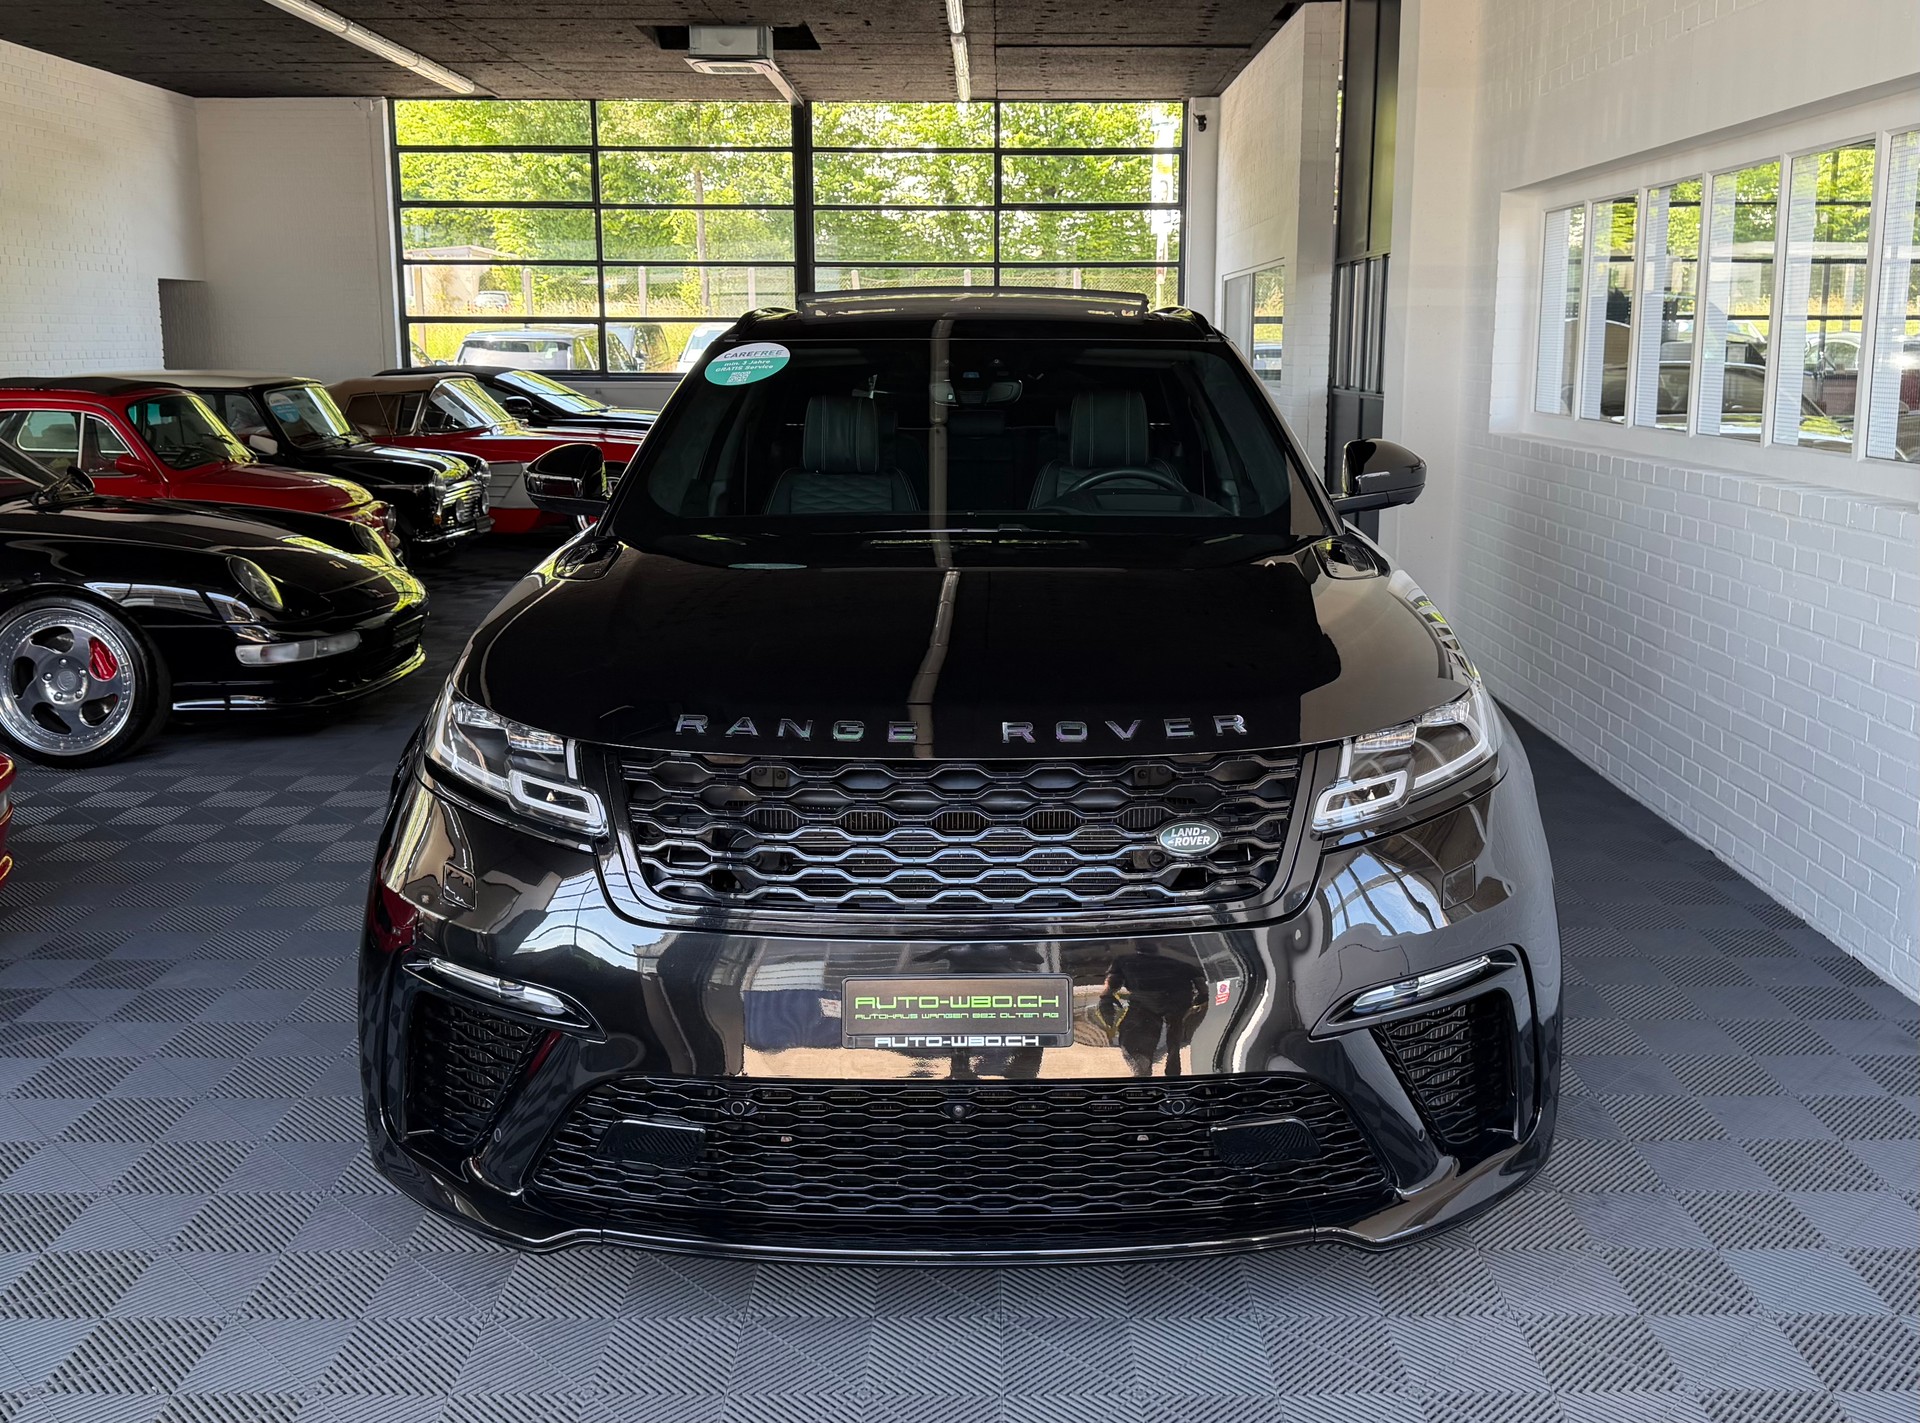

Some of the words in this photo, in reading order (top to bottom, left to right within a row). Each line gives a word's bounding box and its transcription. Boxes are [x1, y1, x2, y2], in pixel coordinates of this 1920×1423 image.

[724, 349, 784, 359] CAREFREE
[675, 714, 918, 743] RANGE
[1002, 714, 1248, 744] ROVER
[1171, 827, 1200, 837] LAND
[1174, 835, 1211, 847] ROVER
[855, 995, 1059, 1009] AUTO-WBO.CH
[874, 1036, 1039, 1048] AUTO-WBO.CH
